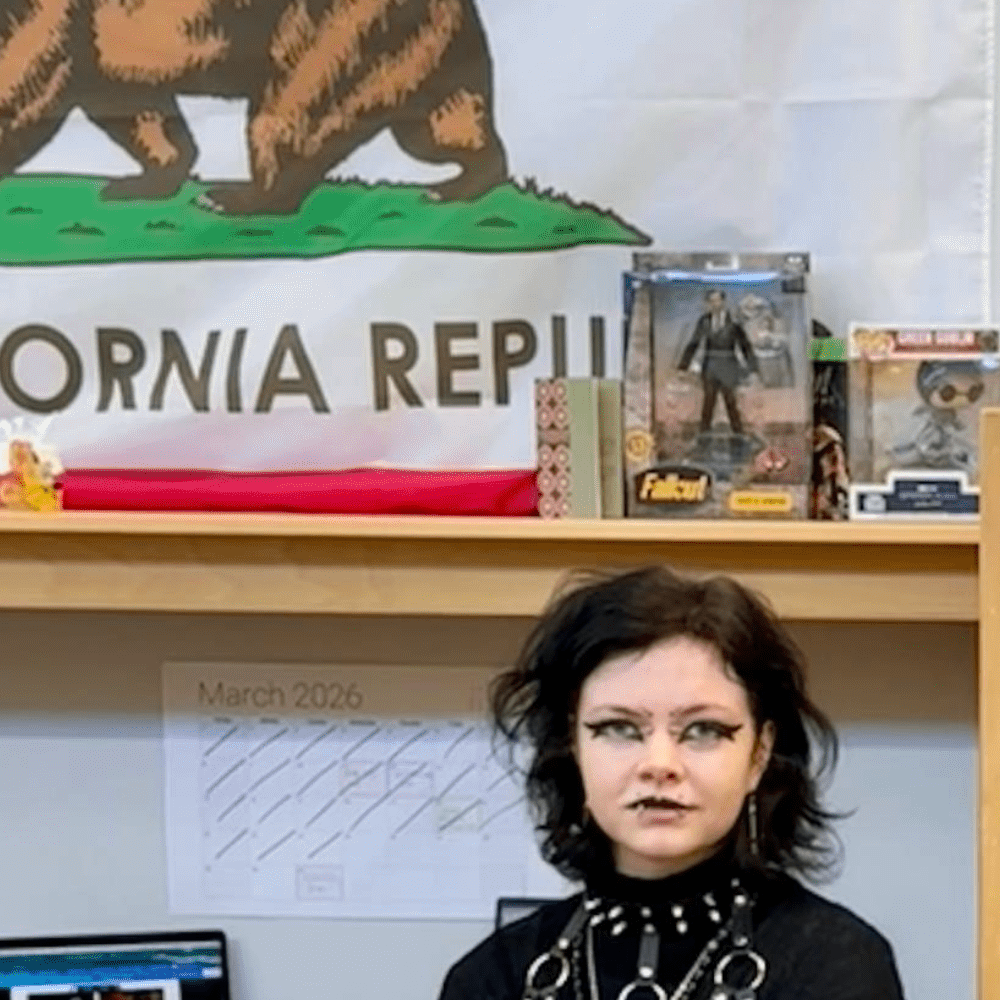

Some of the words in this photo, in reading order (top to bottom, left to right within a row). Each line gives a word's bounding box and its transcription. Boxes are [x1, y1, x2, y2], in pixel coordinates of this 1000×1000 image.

[0, 323, 331, 415] ORNIA
[199, 680, 286, 708] March
[292, 681, 363, 710] 2026
